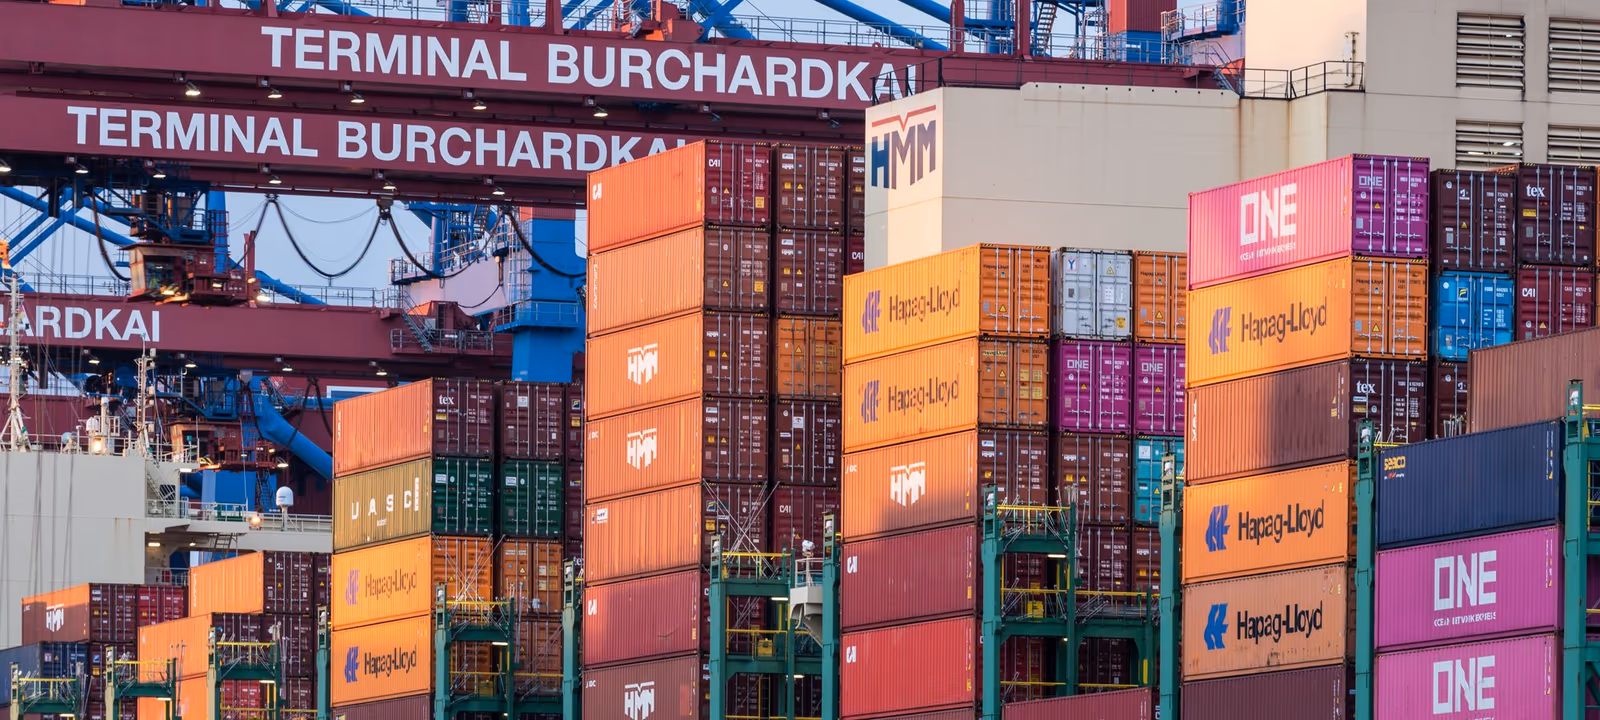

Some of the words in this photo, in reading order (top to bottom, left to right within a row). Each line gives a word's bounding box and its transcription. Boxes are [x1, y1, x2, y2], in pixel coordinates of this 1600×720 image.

[261, 26, 527, 81] TERMINAL
[548, 43, 916, 102] BURCHARDKAI
[67, 106, 318, 158] TERMINAL
[338, 121, 686, 171] BURCHARDK
[871, 119, 937, 190] HMM
[1359, 175, 1383, 186] ONE
[1526, 184, 1546, 197] tex
[1240, 182, 1297, 246] ONE
[0, 303, 160, 343] ARDKAI
[888, 279, 961, 326] Hapag-Lloyd
[1241, 295, 1327, 346] Hapag-Lloyd
[1066, 359, 1090, 369] ONE
[1141, 362, 1164, 373] ONE
[438, 394, 454, 405] tex
[887, 372, 959, 416] Hapag-Lloyd
[1356, 380, 1376, 394] tex
[1238, 499, 1325, 546] Hapag-Lloyd
[364, 566, 417, 601] Hapag-Lloyd
[1434, 550, 1497, 612] ONE
[1236, 600, 1323, 645] Hapag-Lloyd
[364, 645, 417, 679] Hapag-Lloyd
[1433, 655, 1496, 715] ONE
